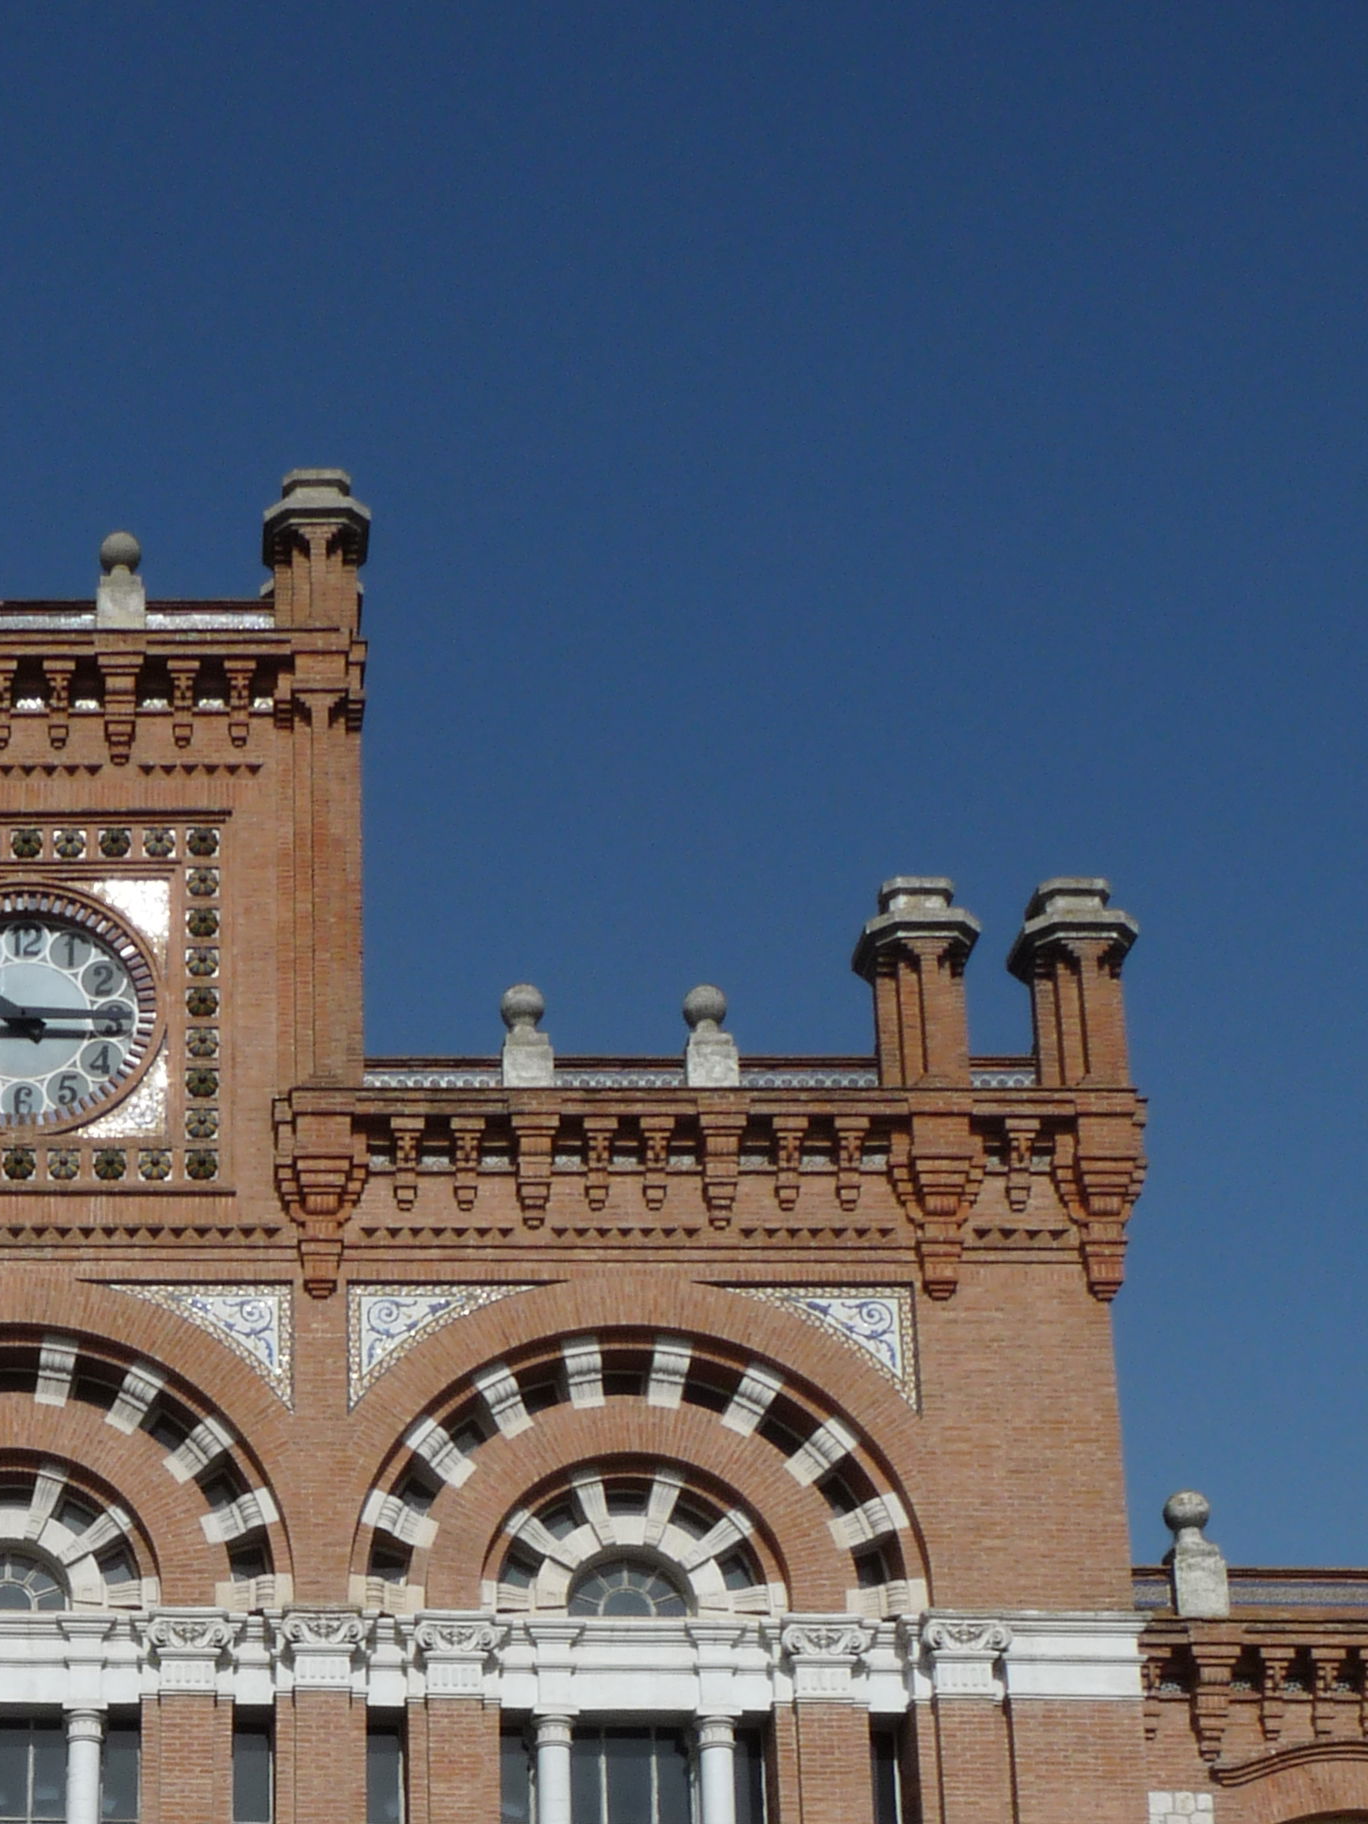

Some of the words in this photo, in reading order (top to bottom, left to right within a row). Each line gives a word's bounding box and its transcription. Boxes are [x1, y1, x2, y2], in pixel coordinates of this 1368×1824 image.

[14, 926, 42, 957] 12
[64, 933, 75, 968] 1
[93, 965, 114, 997] 2
[104, 1004, 124, 1035] 3
[89, 1044, 110, 1075] 4
[14, 1086, 33, 1116] 6
[57, 1075, 78, 1105] 5
